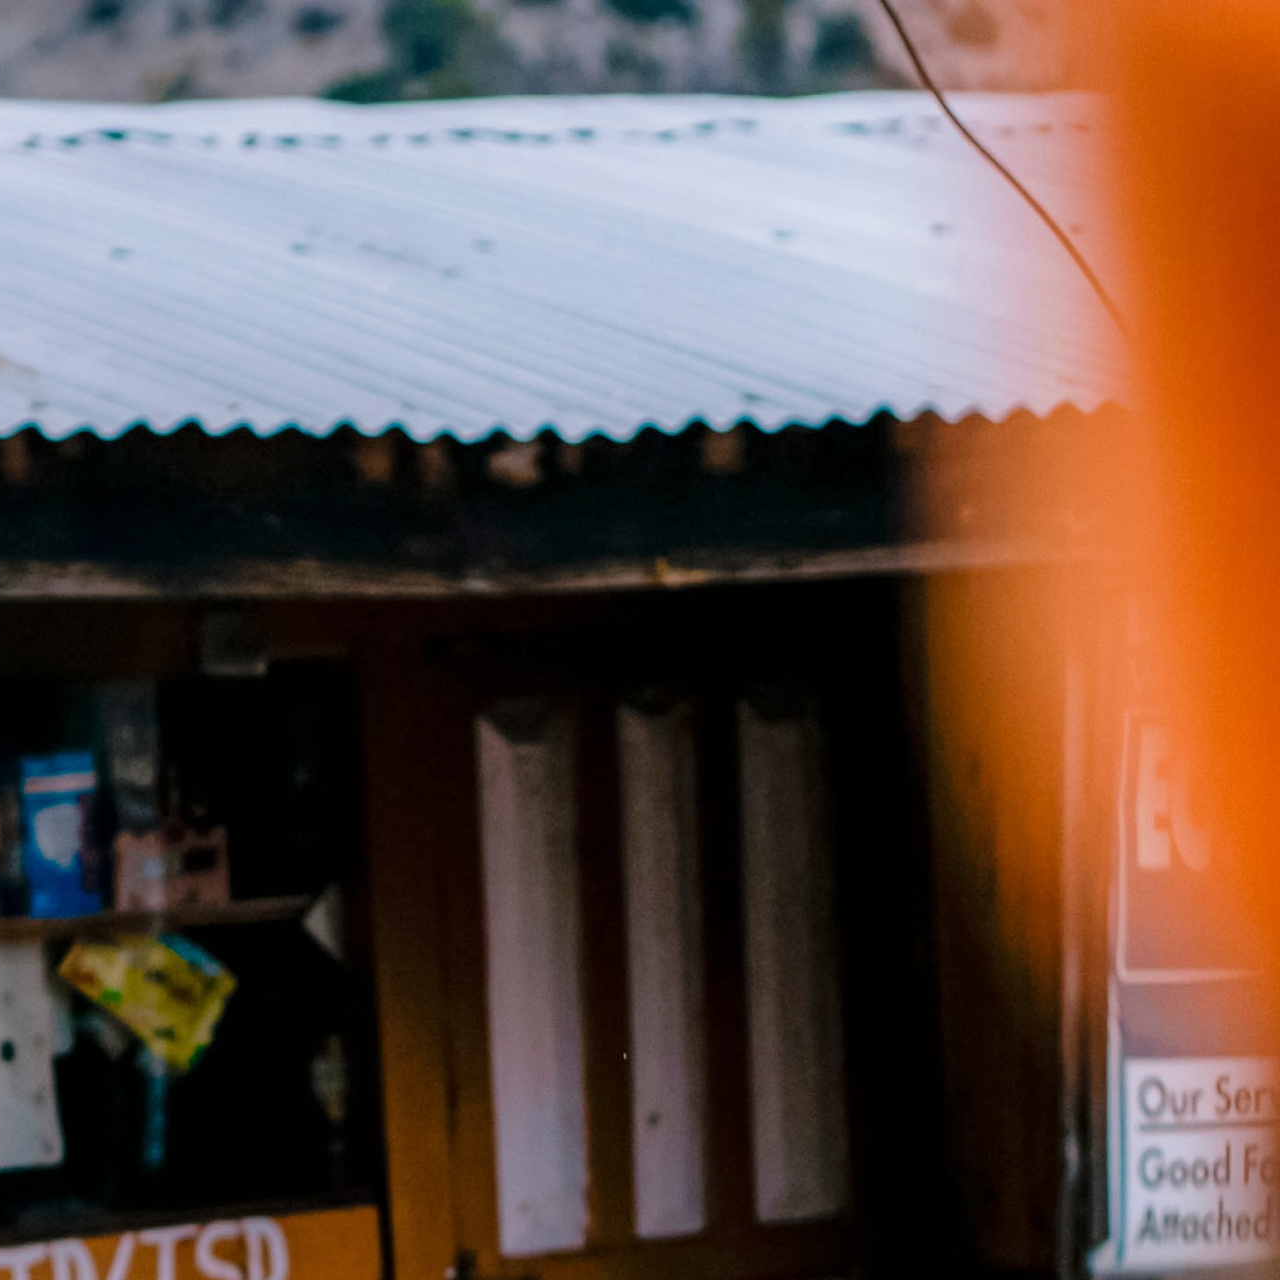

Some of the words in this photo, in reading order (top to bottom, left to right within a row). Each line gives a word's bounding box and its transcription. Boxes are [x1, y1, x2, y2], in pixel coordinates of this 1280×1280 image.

[1138, 1075, 1202, 1118] Our
[1139, 1139, 1230, 1188] Good
[1137, 1194, 1272, 1241] Attached
